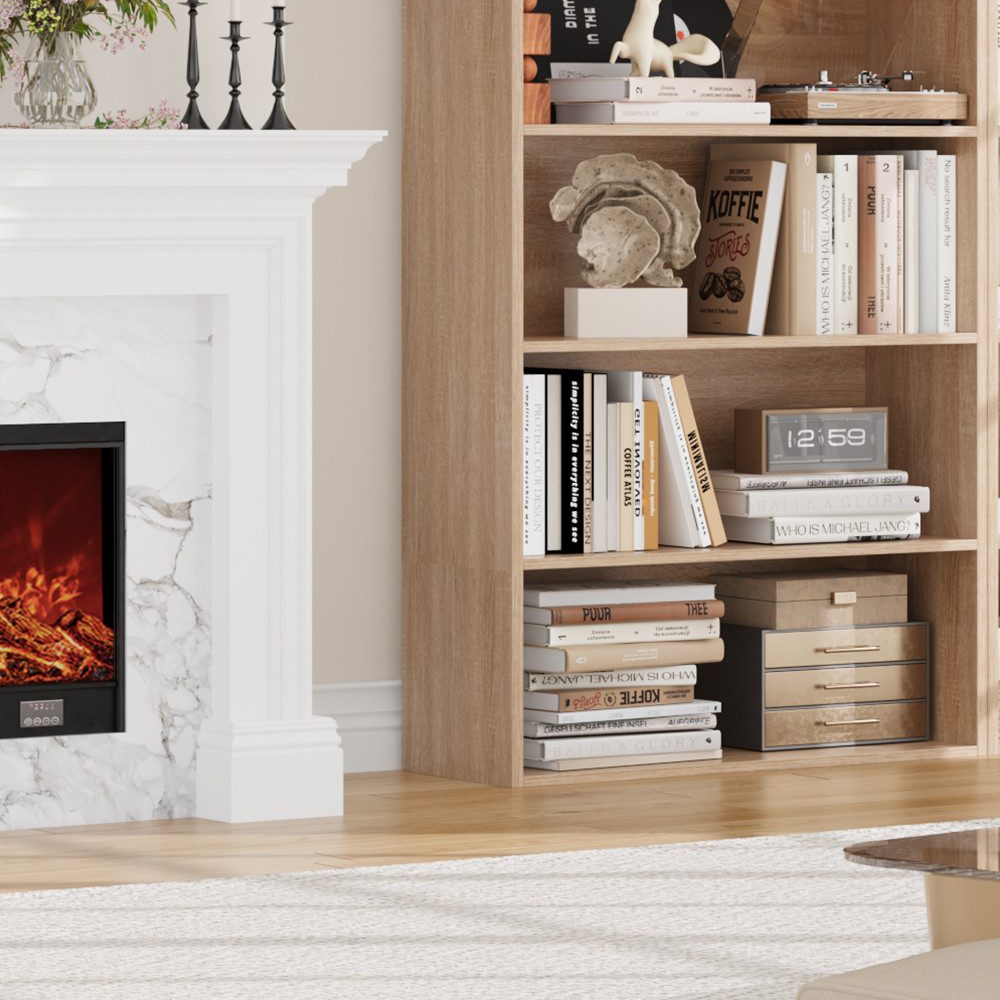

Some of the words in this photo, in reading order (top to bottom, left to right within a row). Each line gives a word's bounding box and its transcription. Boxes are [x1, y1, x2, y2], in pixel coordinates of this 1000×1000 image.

[583, 7, 598, 29] THE
[883, 163, 890, 173] 2
[944, 159, 951, 172] No
[943, 175, 951, 205] search
[706, 189, 763, 225] KOFFIE
[821, 184, 830, 223] JANG?
[943, 207, 951, 234] result
[705, 230, 751, 268] STORIES
[943, 235, 951, 248] for
[821, 225, 829, 283] MICHAEL
[822, 286, 829, 300] IS
[943, 276, 951, 301] Anita
[822, 300, 830, 334] WHO
[943, 303, 951, 328] Klinz
[570, 380, 580, 430] simplicity
[571, 431, 579, 441] is
[571, 443, 579, 453] in
[584, 432, 592, 456] THE
[787, 429, 815, 448] 12
[827, 428, 867, 447] 59
[623, 447, 632, 479] COFFEE
[570, 456, 580, 508] everything
[584, 463, 592, 496] NEXT
[623, 480, 631, 507] ATLAS
[571, 510, 579, 524] we
[584, 497, 592, 545] DESIGN
[775, 523, 807, 537] WHO
[809, 523, 820, 535] IS
[821, 521, 871, 535] MICHAEL
[874, 519, 911, 532] JANG?
[582, 607, 612, 622] PUUR
[684, 602, 709, 616] THEE
[541, 673, 582, 685] JANG?
[584, 672, 644, 683] MICHAEL
[646, 671, 660, 681] IS
[661, 669, 696, 681] WHO
